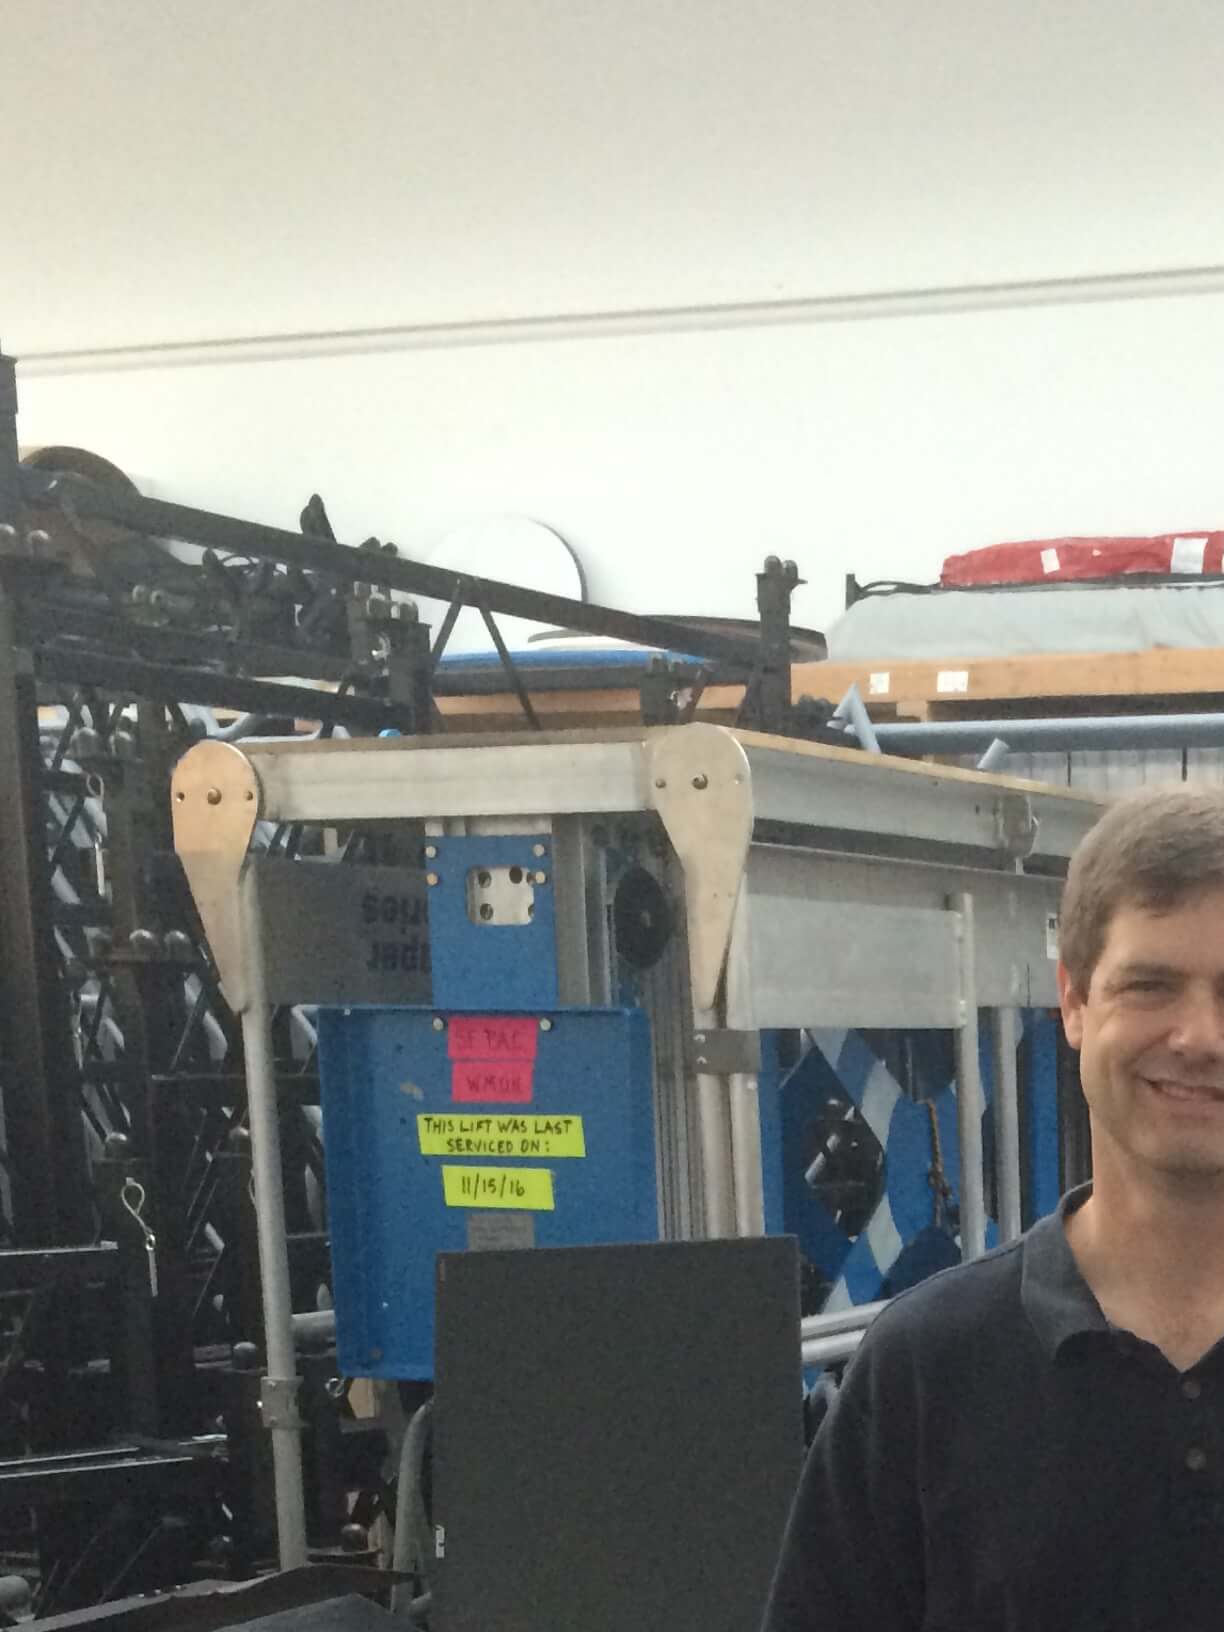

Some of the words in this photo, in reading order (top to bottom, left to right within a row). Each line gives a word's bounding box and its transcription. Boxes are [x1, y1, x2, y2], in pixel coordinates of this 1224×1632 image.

[424, 1117, 455, 1134] THIS
[459, 1118, 493, 1133] LIFT
[497, 1118, 528, 1134] WAS
[533, 1119, 573, 1135] LAST
[446, 1138, 514, 1154] SERVICED
[461, 1172, 526, 1200] 11/15/16
